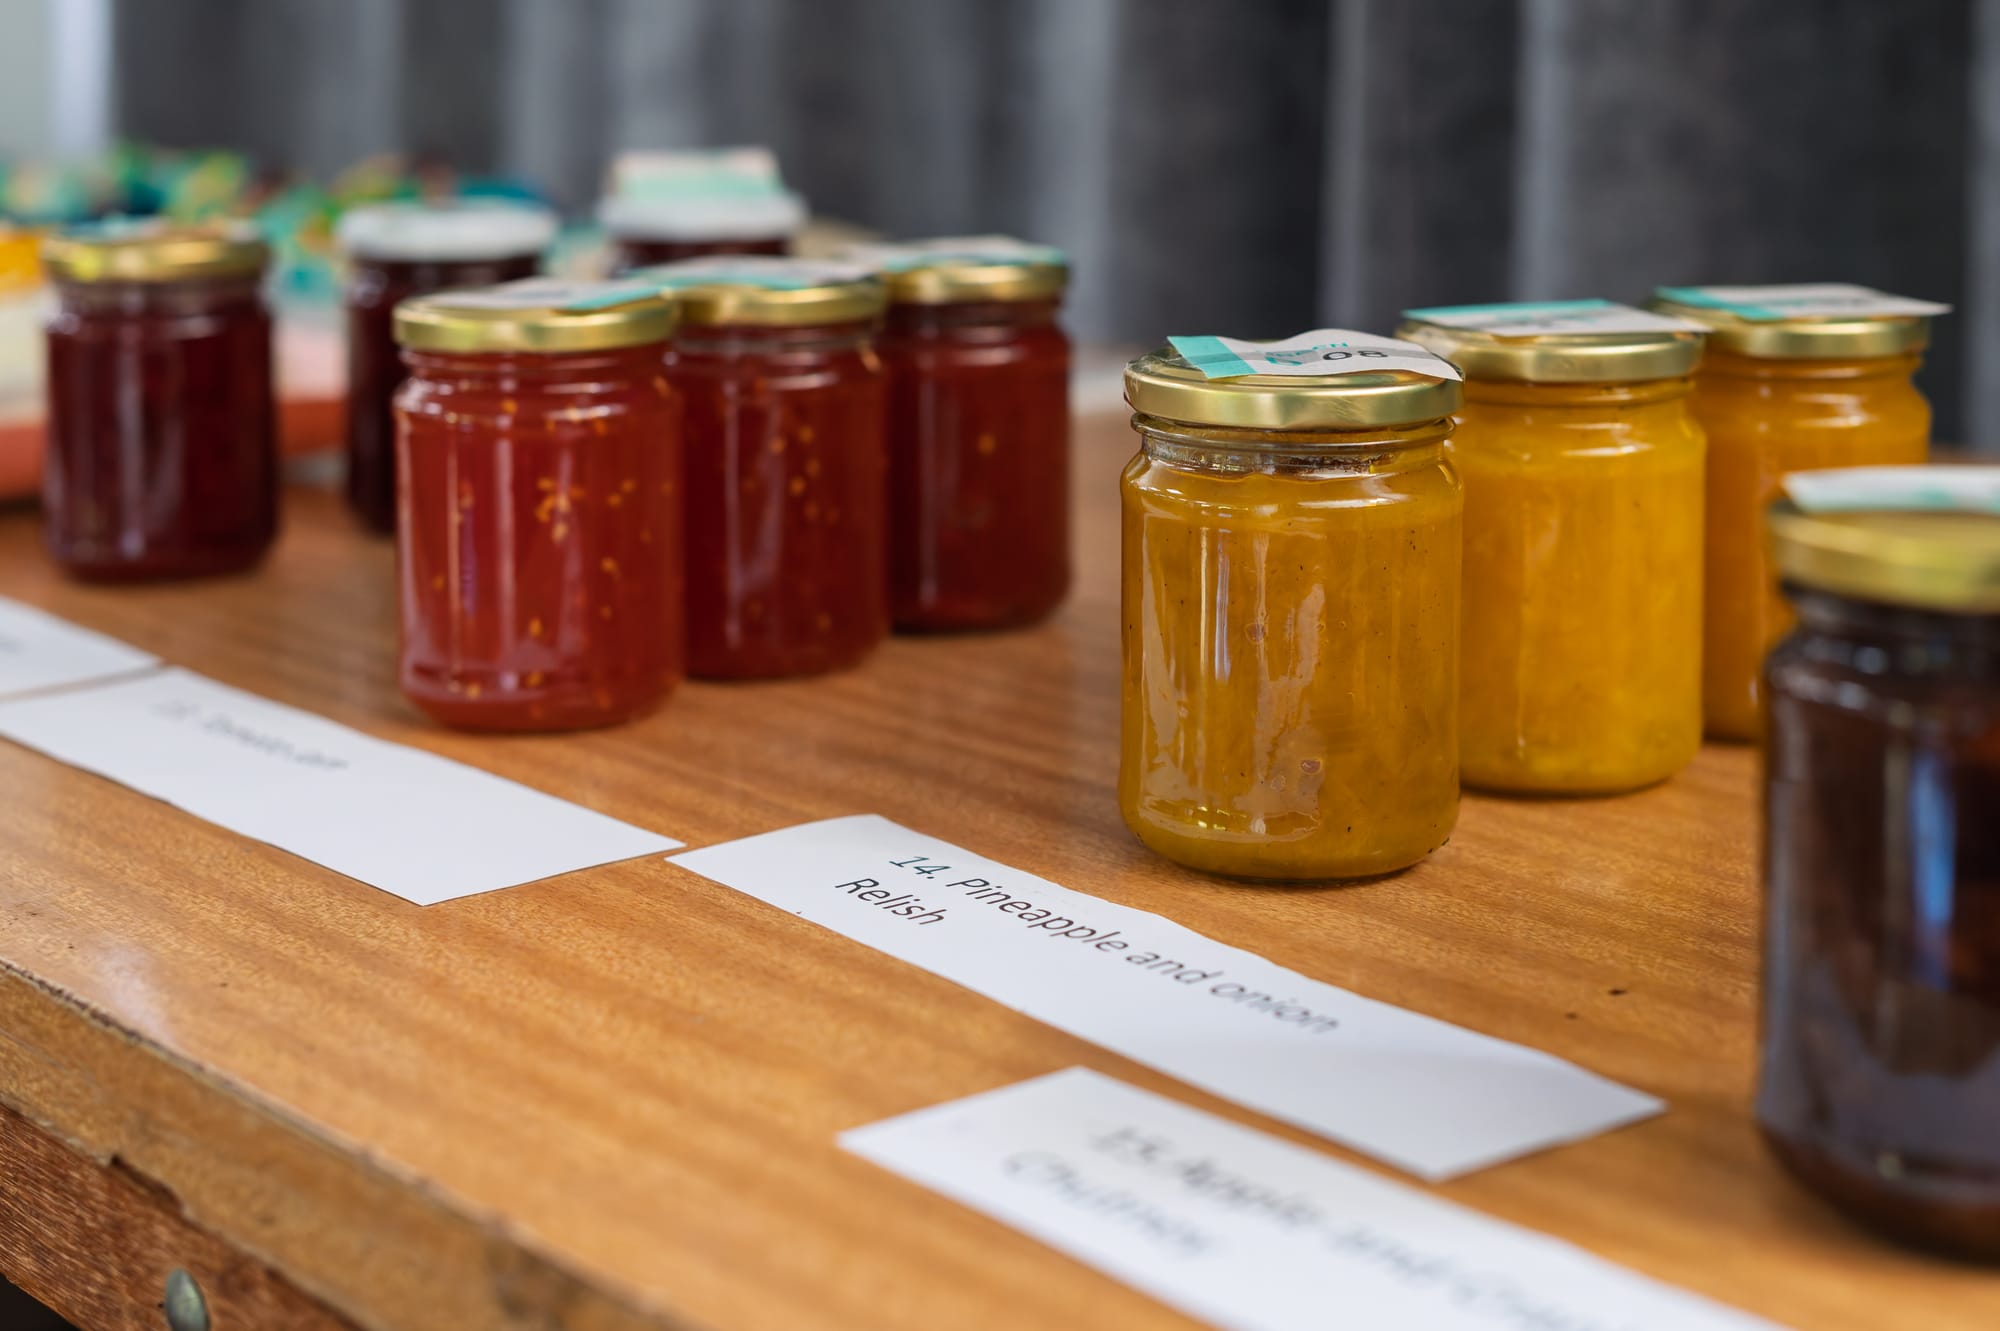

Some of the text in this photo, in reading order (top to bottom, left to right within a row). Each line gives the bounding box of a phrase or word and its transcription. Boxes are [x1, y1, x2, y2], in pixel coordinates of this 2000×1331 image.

[834, 877, 948, 926] Relish
[889, 855, 1340, 1034] 14. Pineapple and onion
